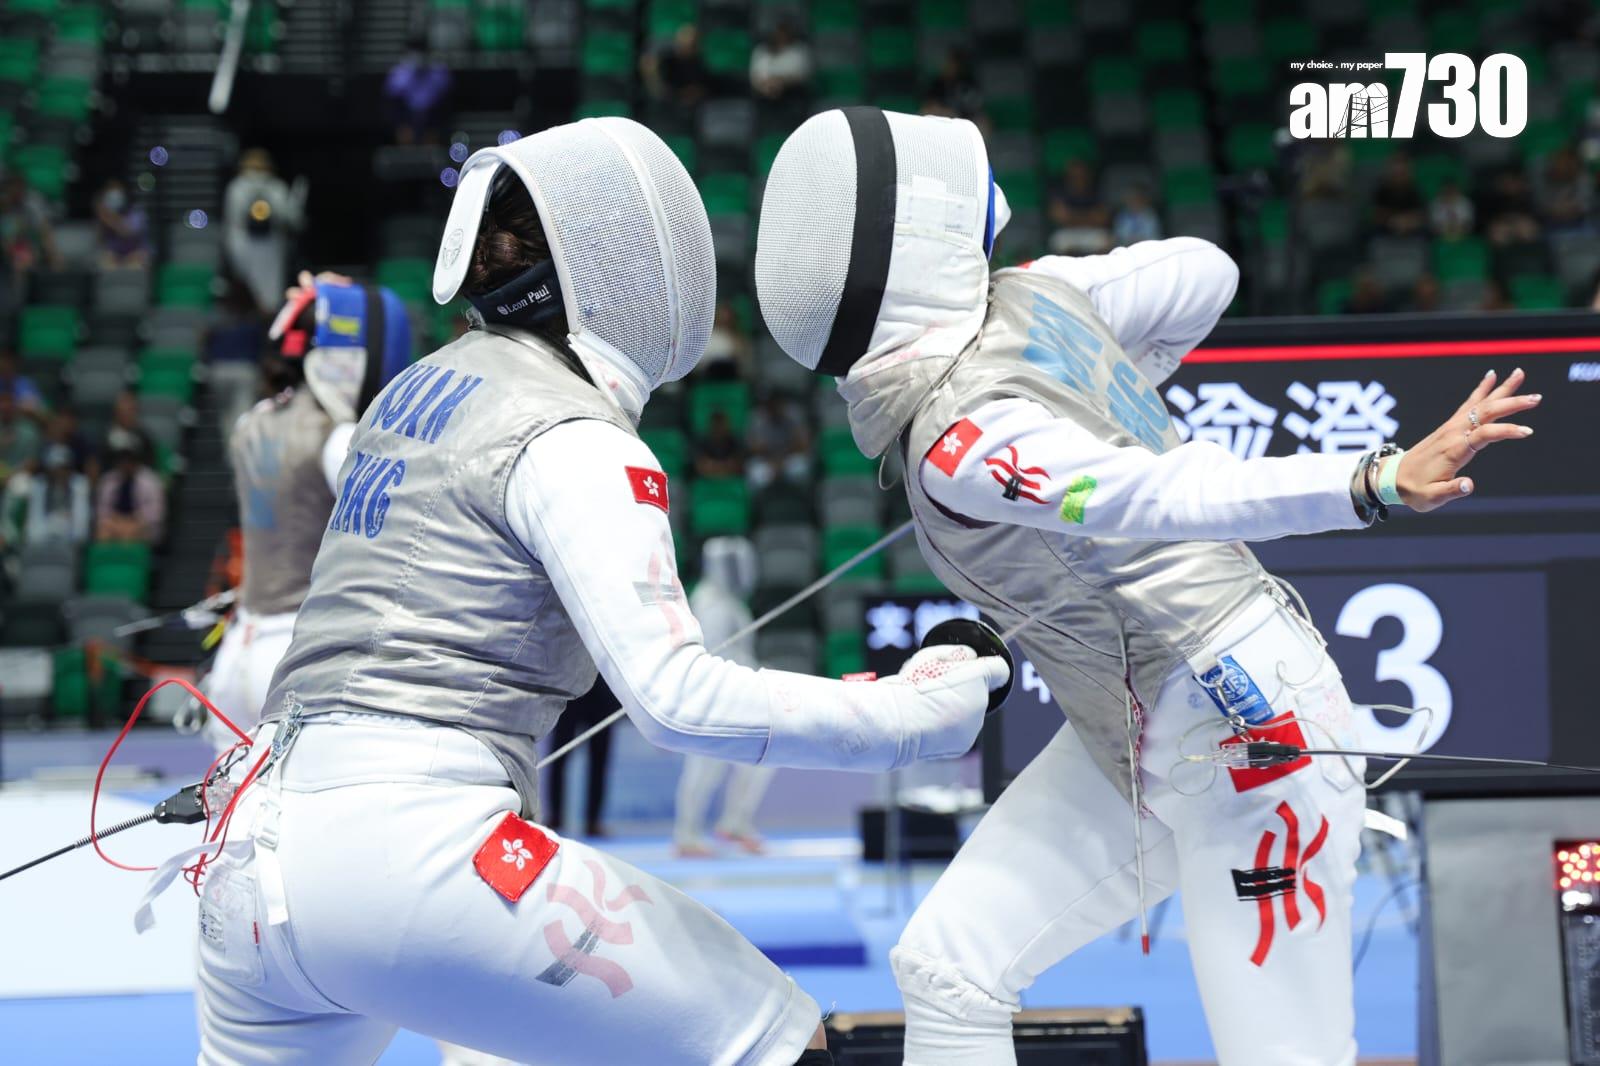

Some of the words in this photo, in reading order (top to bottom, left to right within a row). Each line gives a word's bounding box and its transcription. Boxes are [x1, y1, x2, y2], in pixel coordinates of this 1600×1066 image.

[505, 299, 529, 313] Leon
[527, 284, 550, 304] Paul
[1334, 582, 1455, 755] 3
